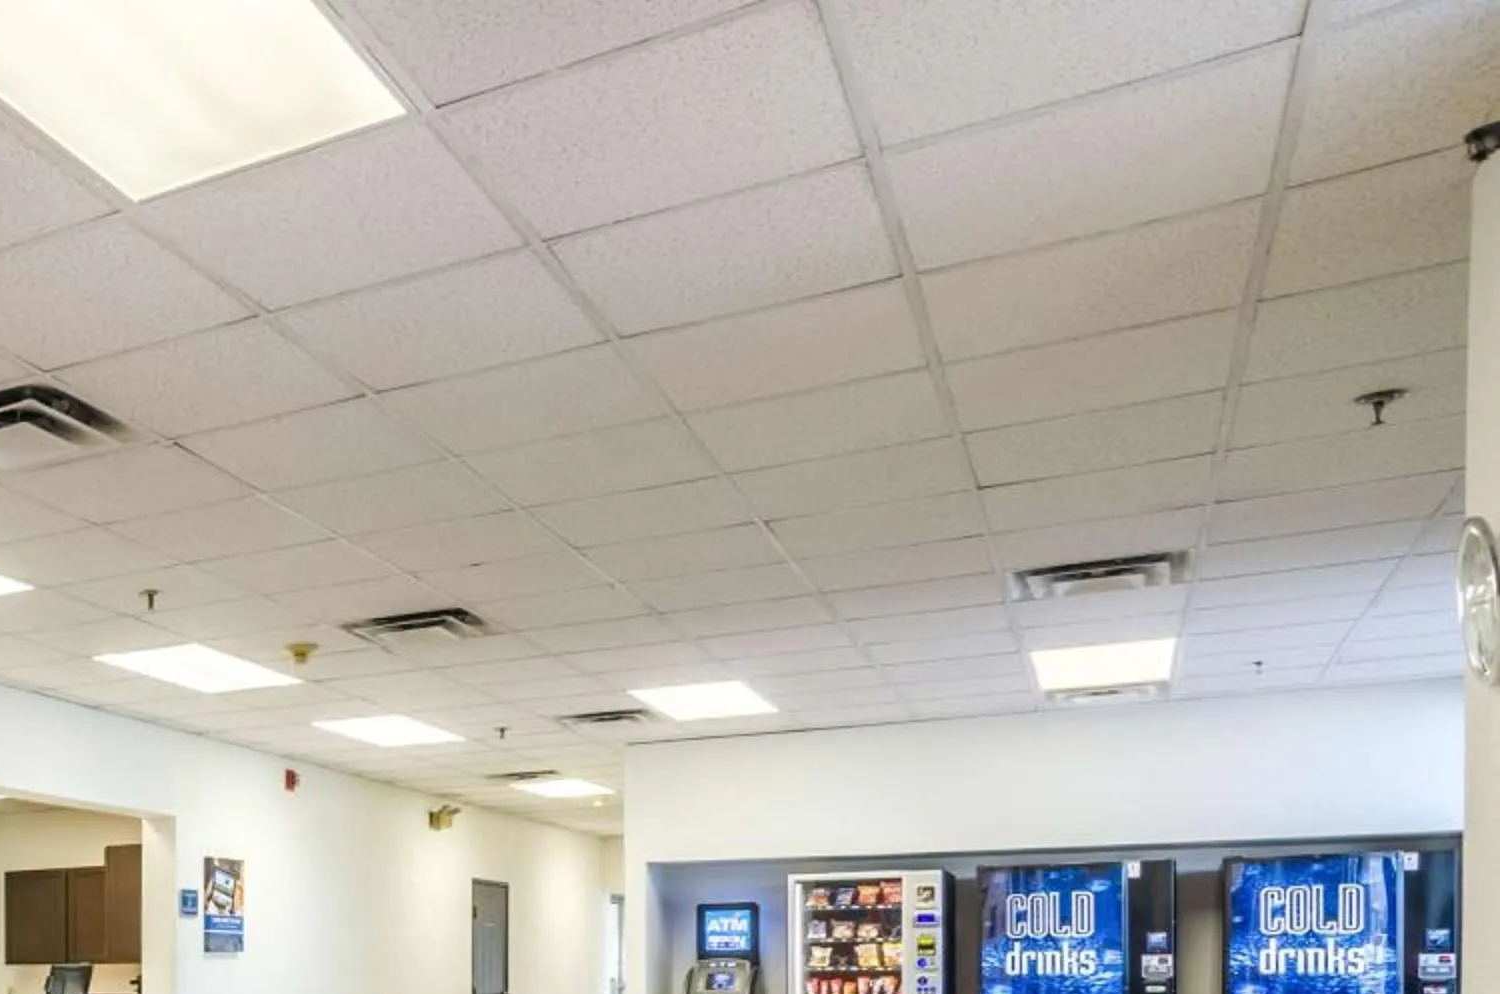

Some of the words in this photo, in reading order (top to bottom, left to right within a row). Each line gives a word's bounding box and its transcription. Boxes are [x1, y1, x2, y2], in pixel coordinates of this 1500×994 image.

[707, 916, 748, 932] ATM
[1006, 891, 1095, 939] COLD
[1260, 883, 1365, 935] COLD
[1005, 941, 1097, 976] drinks
[1259, 937, 1366, 976] drinks
